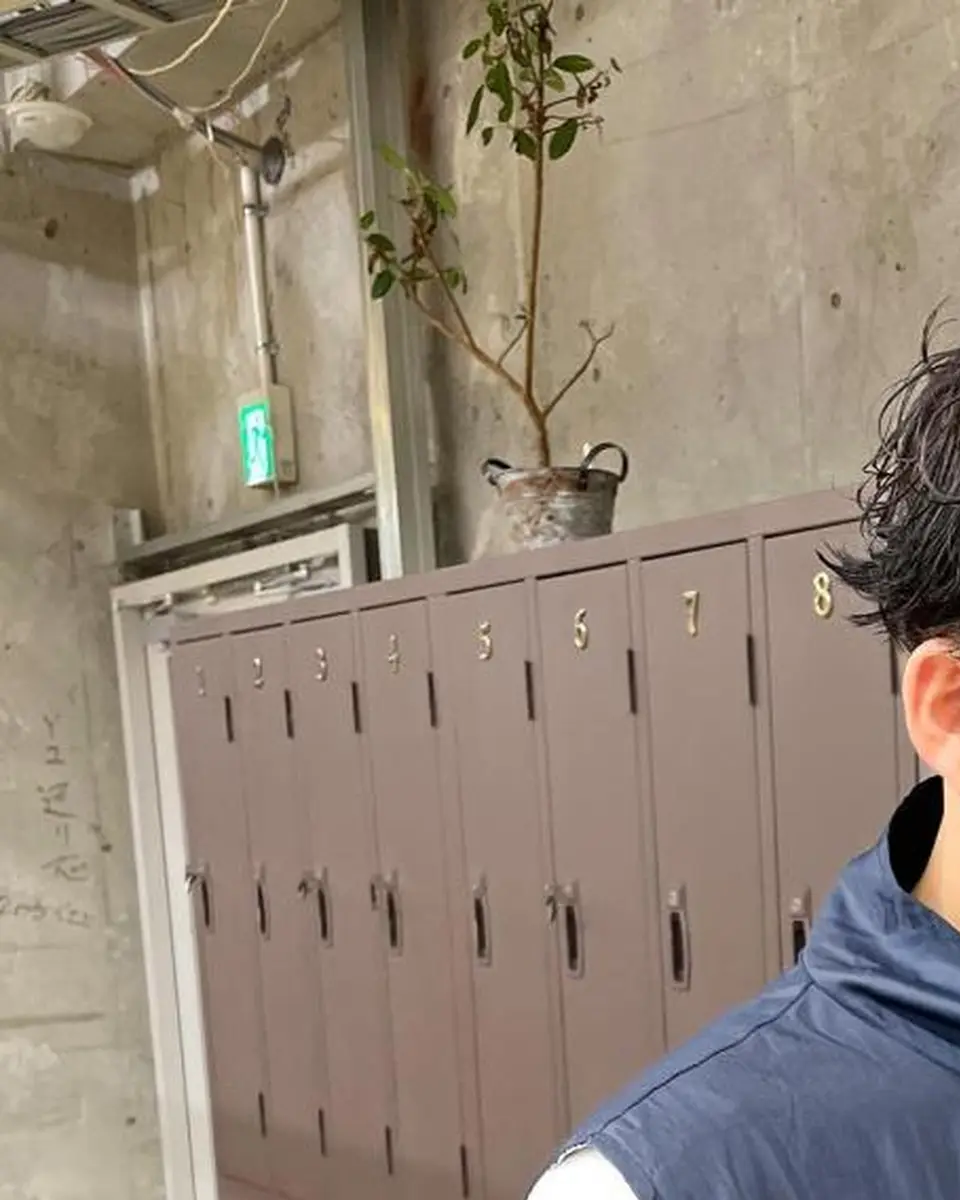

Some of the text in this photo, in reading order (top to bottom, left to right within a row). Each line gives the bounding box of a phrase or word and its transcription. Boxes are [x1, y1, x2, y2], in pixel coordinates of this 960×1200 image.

[680, 590, 699, 637] 7
[813, 571, 833, 619] 8
[477, 620, 493, 661] 5
[573, 608, 589, 650] 6
[314, 647, 329, 682] 3
